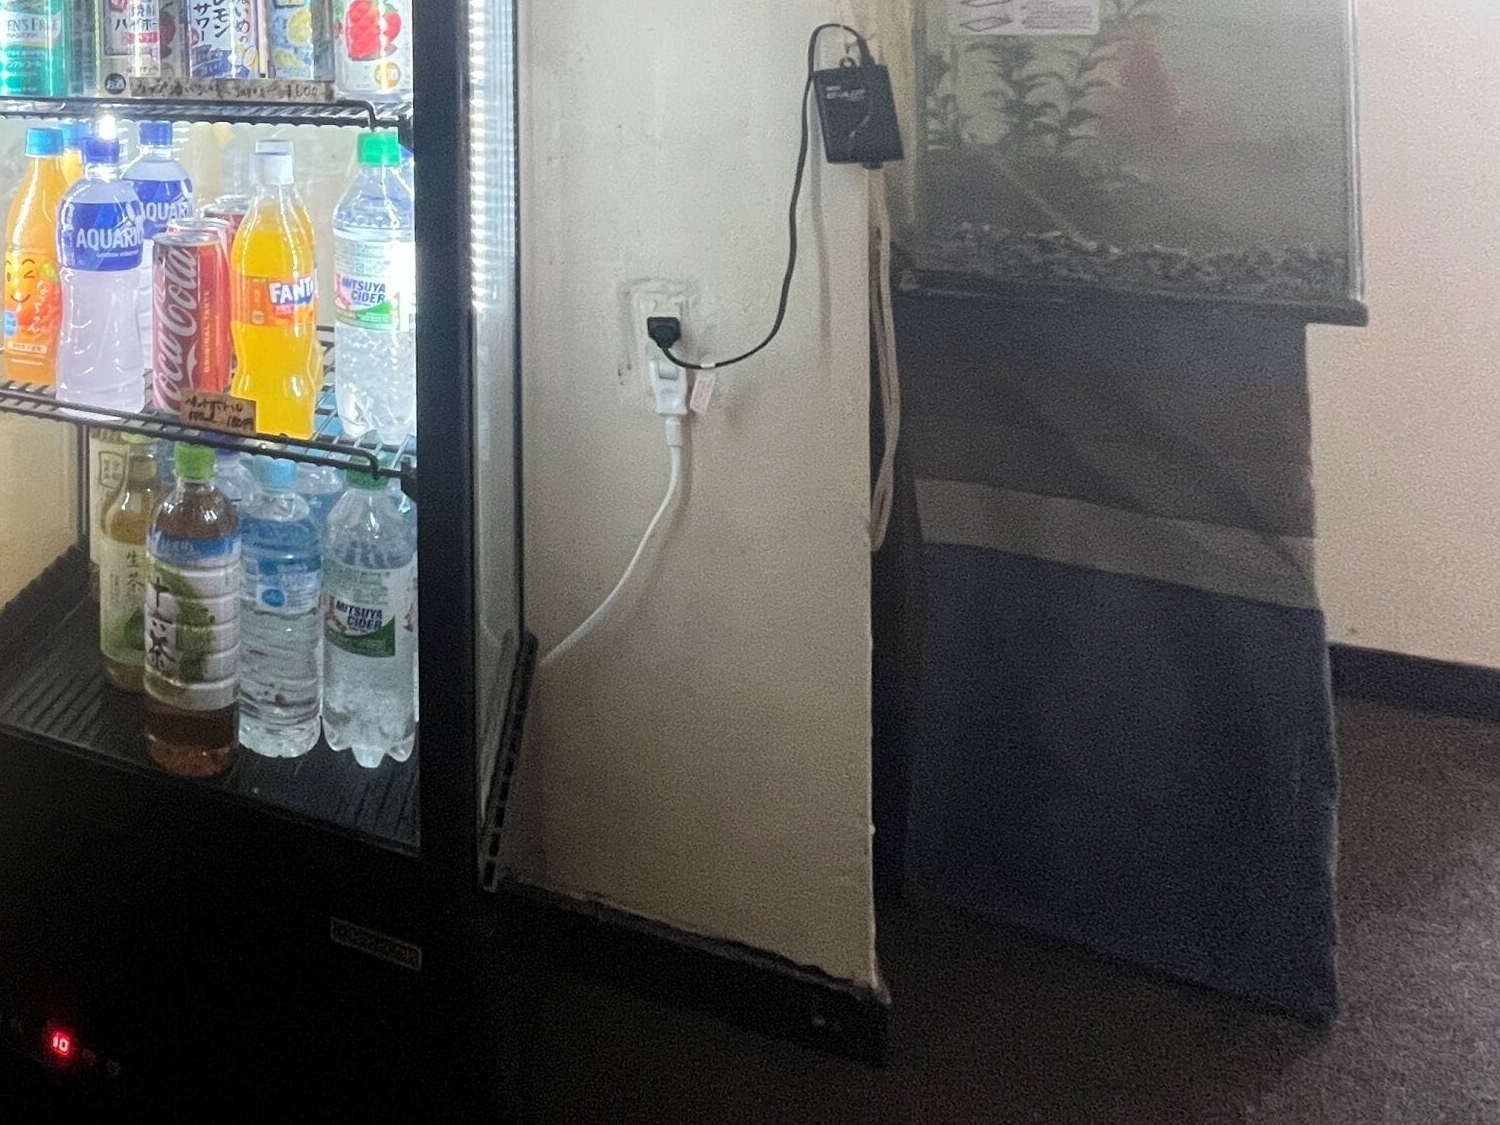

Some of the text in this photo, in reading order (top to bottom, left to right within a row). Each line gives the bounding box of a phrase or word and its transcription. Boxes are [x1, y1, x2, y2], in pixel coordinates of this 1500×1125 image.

[193, 2, 212, 42] サワー
[76, 228, 145, 251] AQUARIU
[350, 290, 386, 304] CIDER
[346, 615, 383, 630] CIDER
